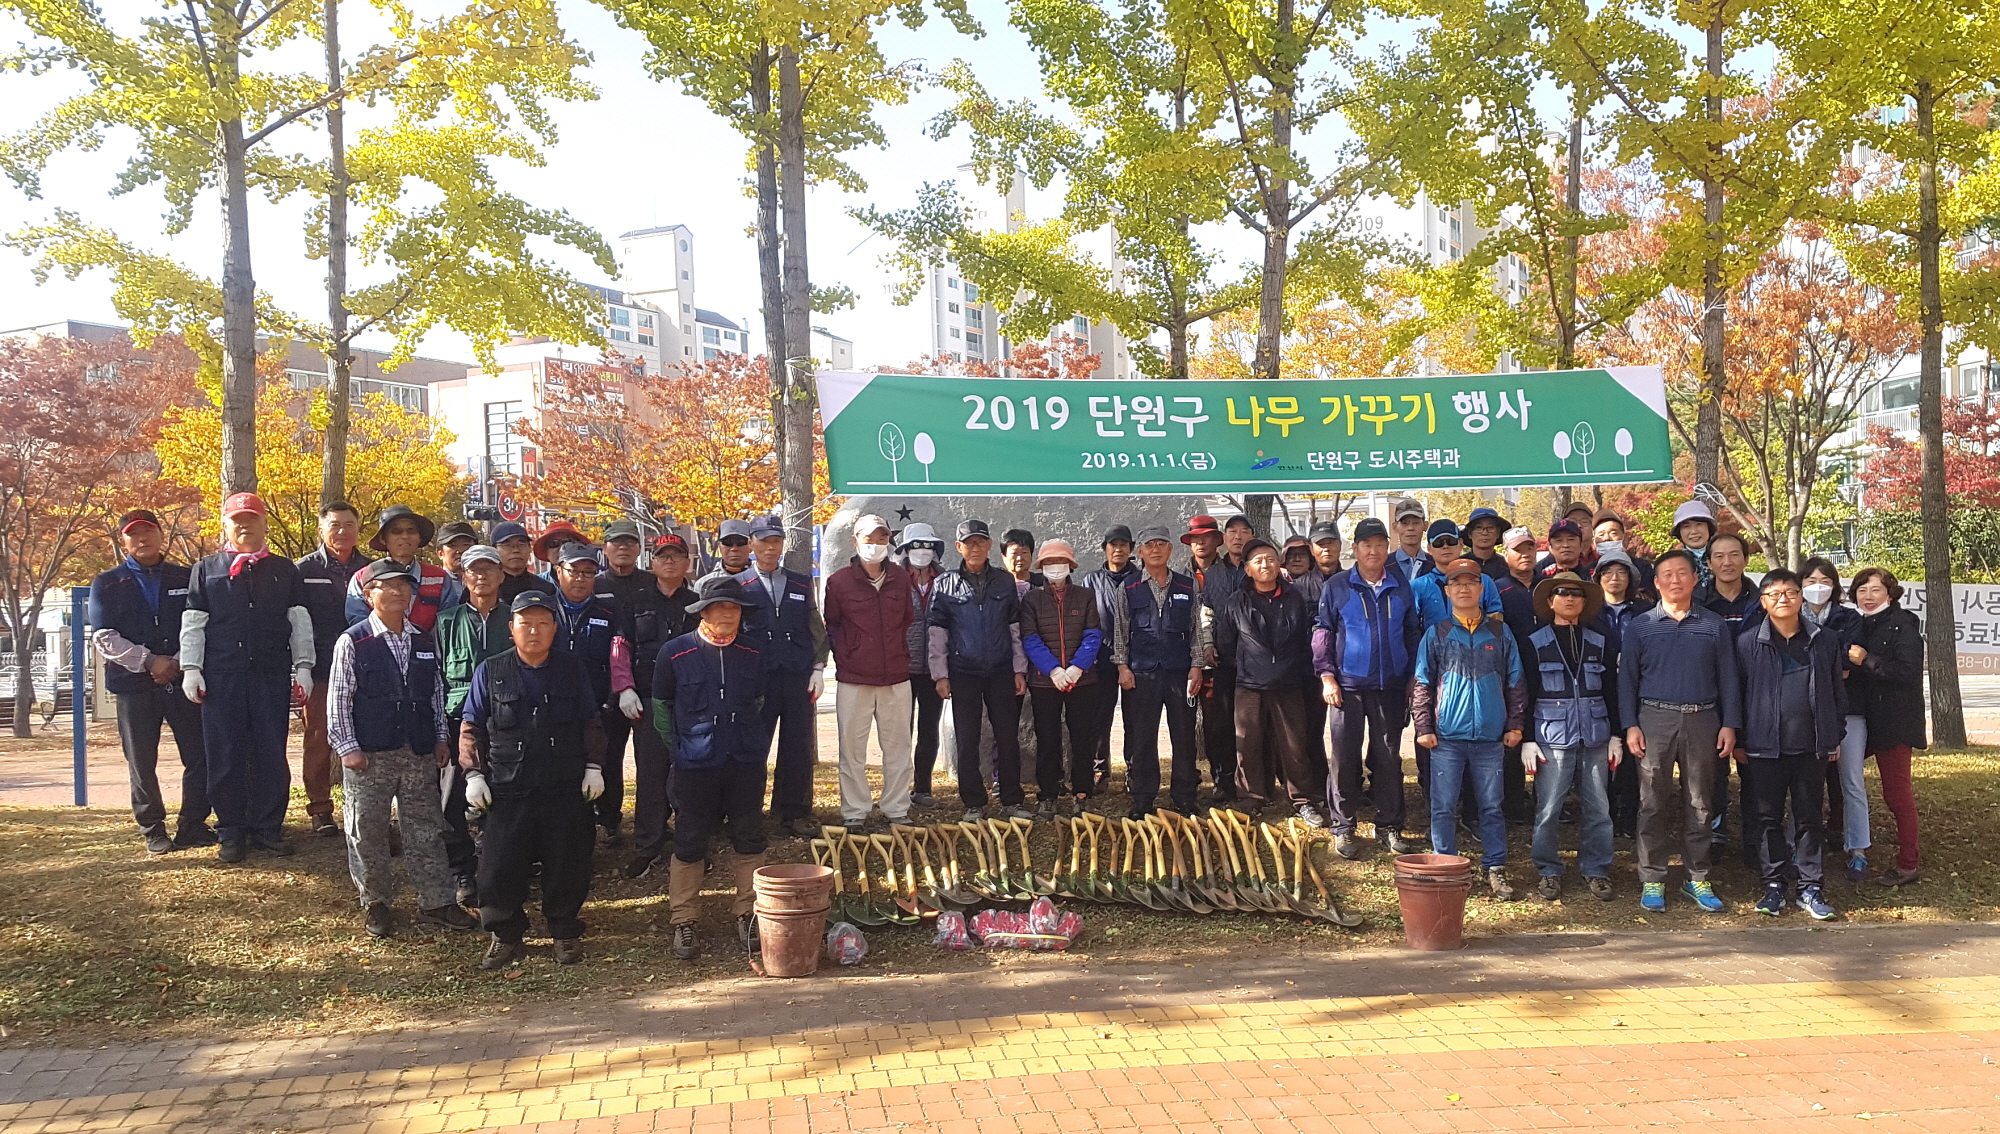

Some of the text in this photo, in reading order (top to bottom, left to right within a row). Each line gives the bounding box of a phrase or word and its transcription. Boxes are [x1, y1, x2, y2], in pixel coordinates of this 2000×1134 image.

[1357, 216, 1383, 231] 109
[962, 388, 1532, 438] 2019 단원구 나무 가꾸기 행사
[1080, 451, 1217, 470] 2019.11.1.(금)
[1306, 448, 1461, 471] 단원구 도시주택과
